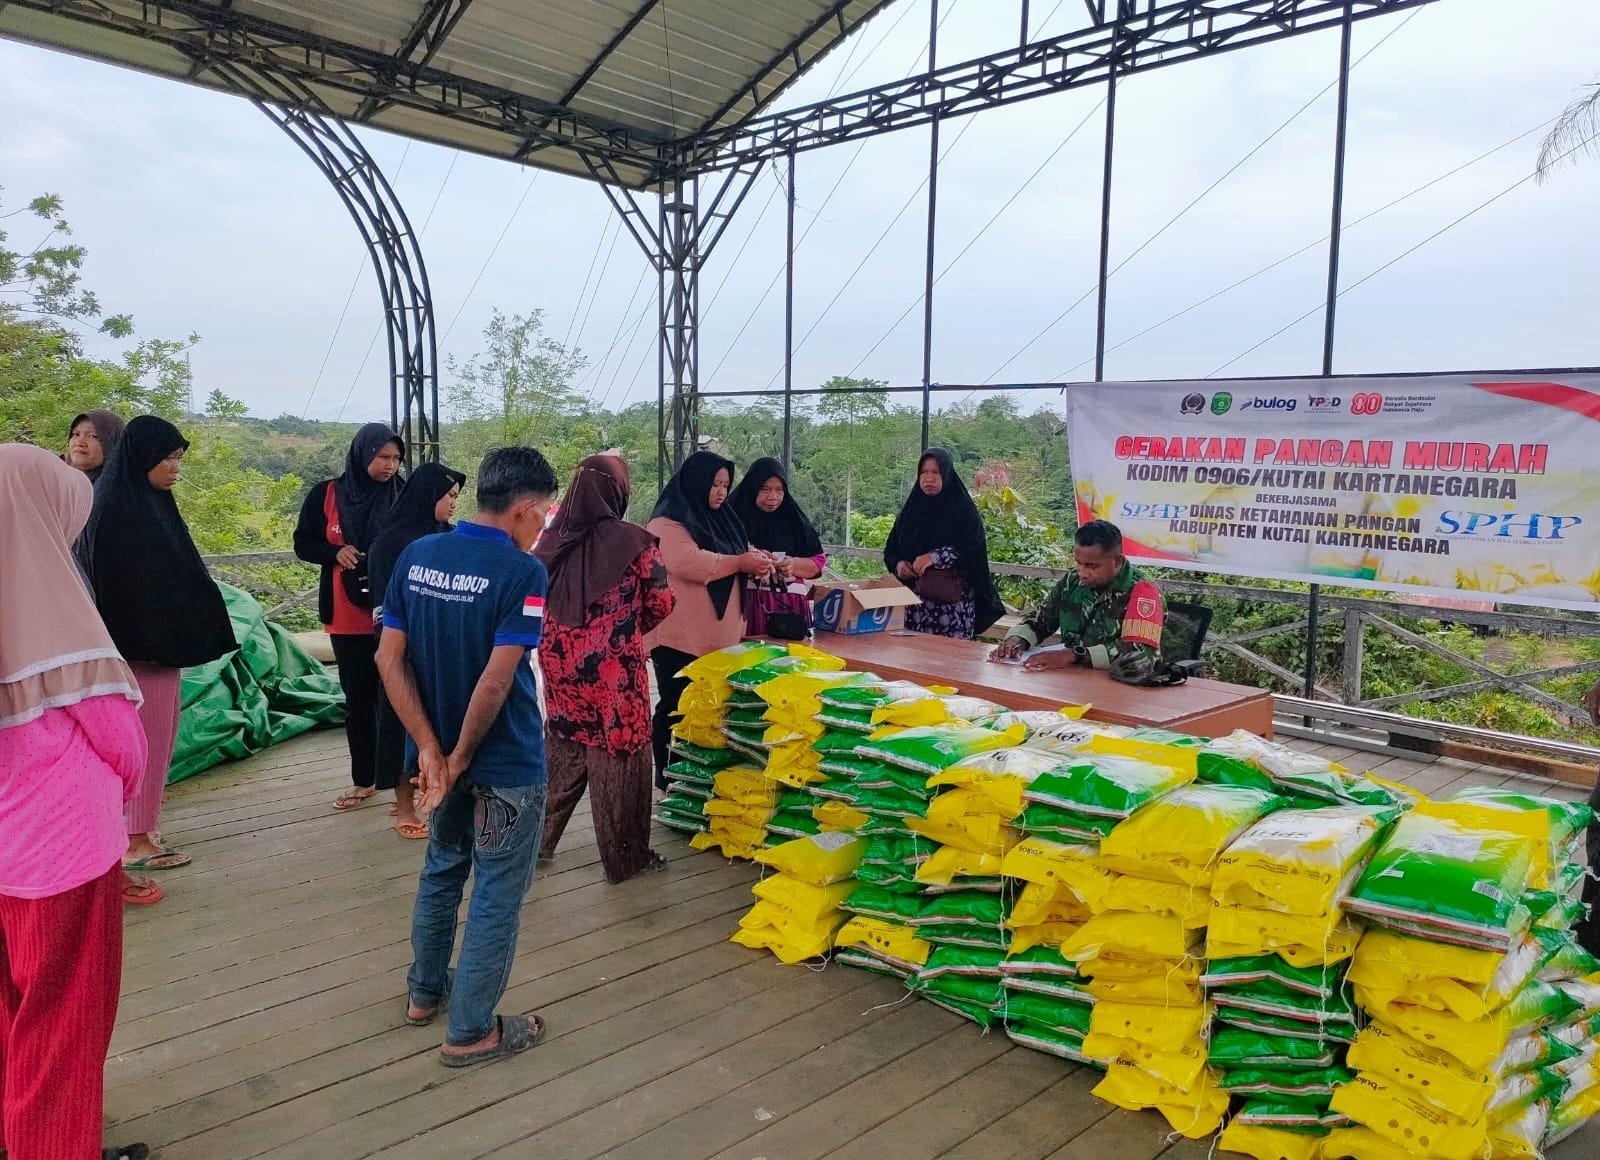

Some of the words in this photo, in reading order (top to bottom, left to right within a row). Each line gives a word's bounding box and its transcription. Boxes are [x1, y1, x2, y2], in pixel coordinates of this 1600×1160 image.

[1253, 396, 1297, 411] bulog
[1114, 435, 1247, 463] GERAKAN
[1253, 438, 1394, 469] PANGAN
[1402, 441, 1549, 475] MURAH
[1126, 463, 1189, 483] KODIM
[1193, 466, 1326, 490] 0906/KUTAI
[1333, 471, 1518, 500] KARTANEGARA
[1120, 502, 1188, 518] SPHP
[1255, 493, 1337, 508] BEKERJASAMA
[1189, 504, 1236, 520] DINAS
[1239, 507, 1339, 528] KETAHANAN
[1344, 514, 1421, 533] PANGAN
[1435, 510, 1583, 539] SPHP
[1169, 519, 1257, 539] KABUPATEN
[1262, 526, 1311, 544] KUTAI
[1315, 530, 1451, 556] KARTANEGARA
[407, 564, 450, 590] GHANESA
[451, 574, 490, 594] GROUP
